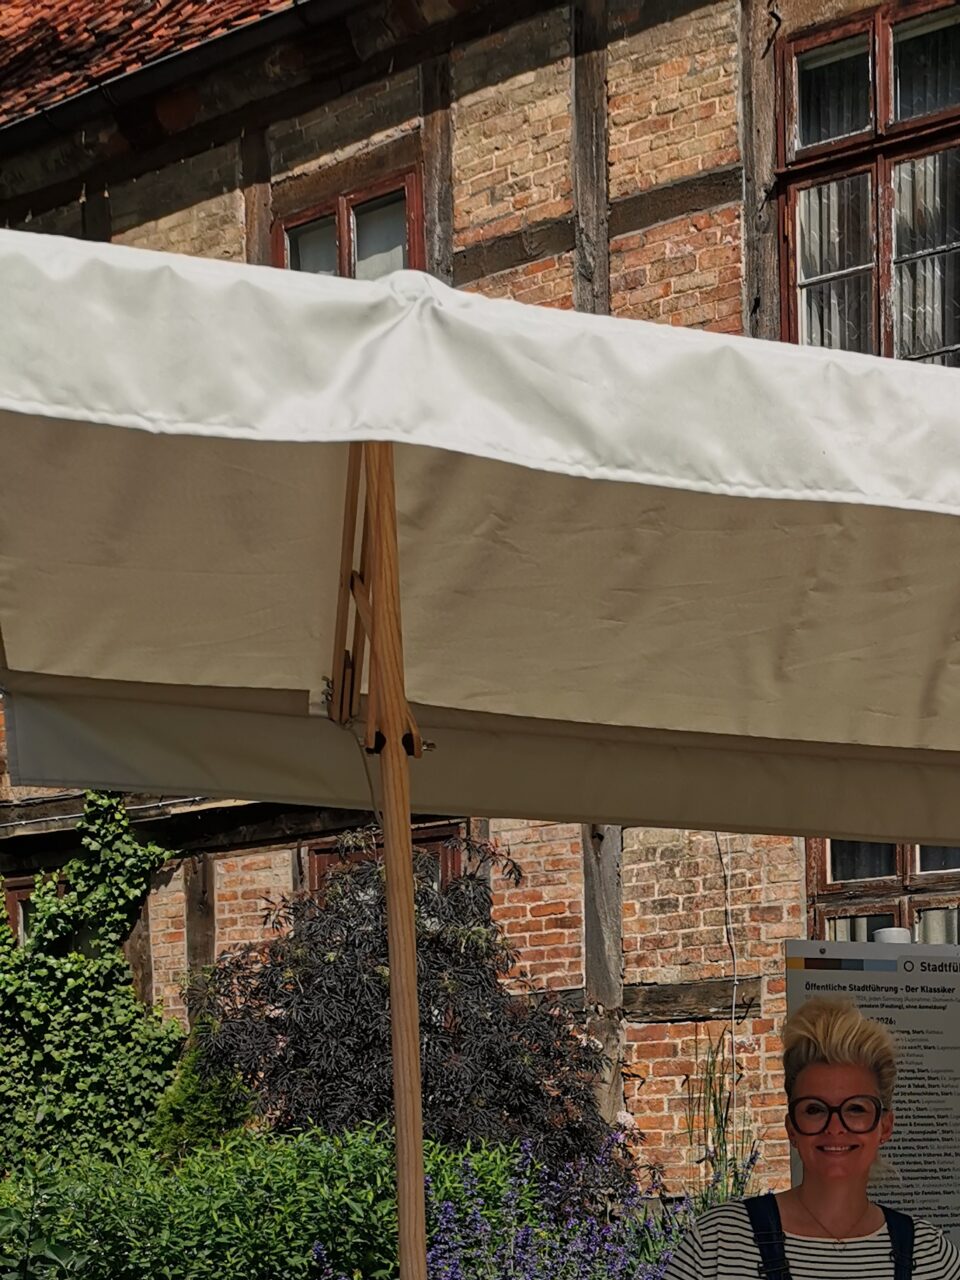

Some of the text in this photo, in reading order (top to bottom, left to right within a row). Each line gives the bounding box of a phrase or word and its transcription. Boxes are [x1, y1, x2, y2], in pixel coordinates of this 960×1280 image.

[805, 981, 847, 992] Öffentliche
[849, 984, 898, 994] Stadtführung
[905, 985, 919, 993] Der
[920, 986, 956, 994] Klassiker
